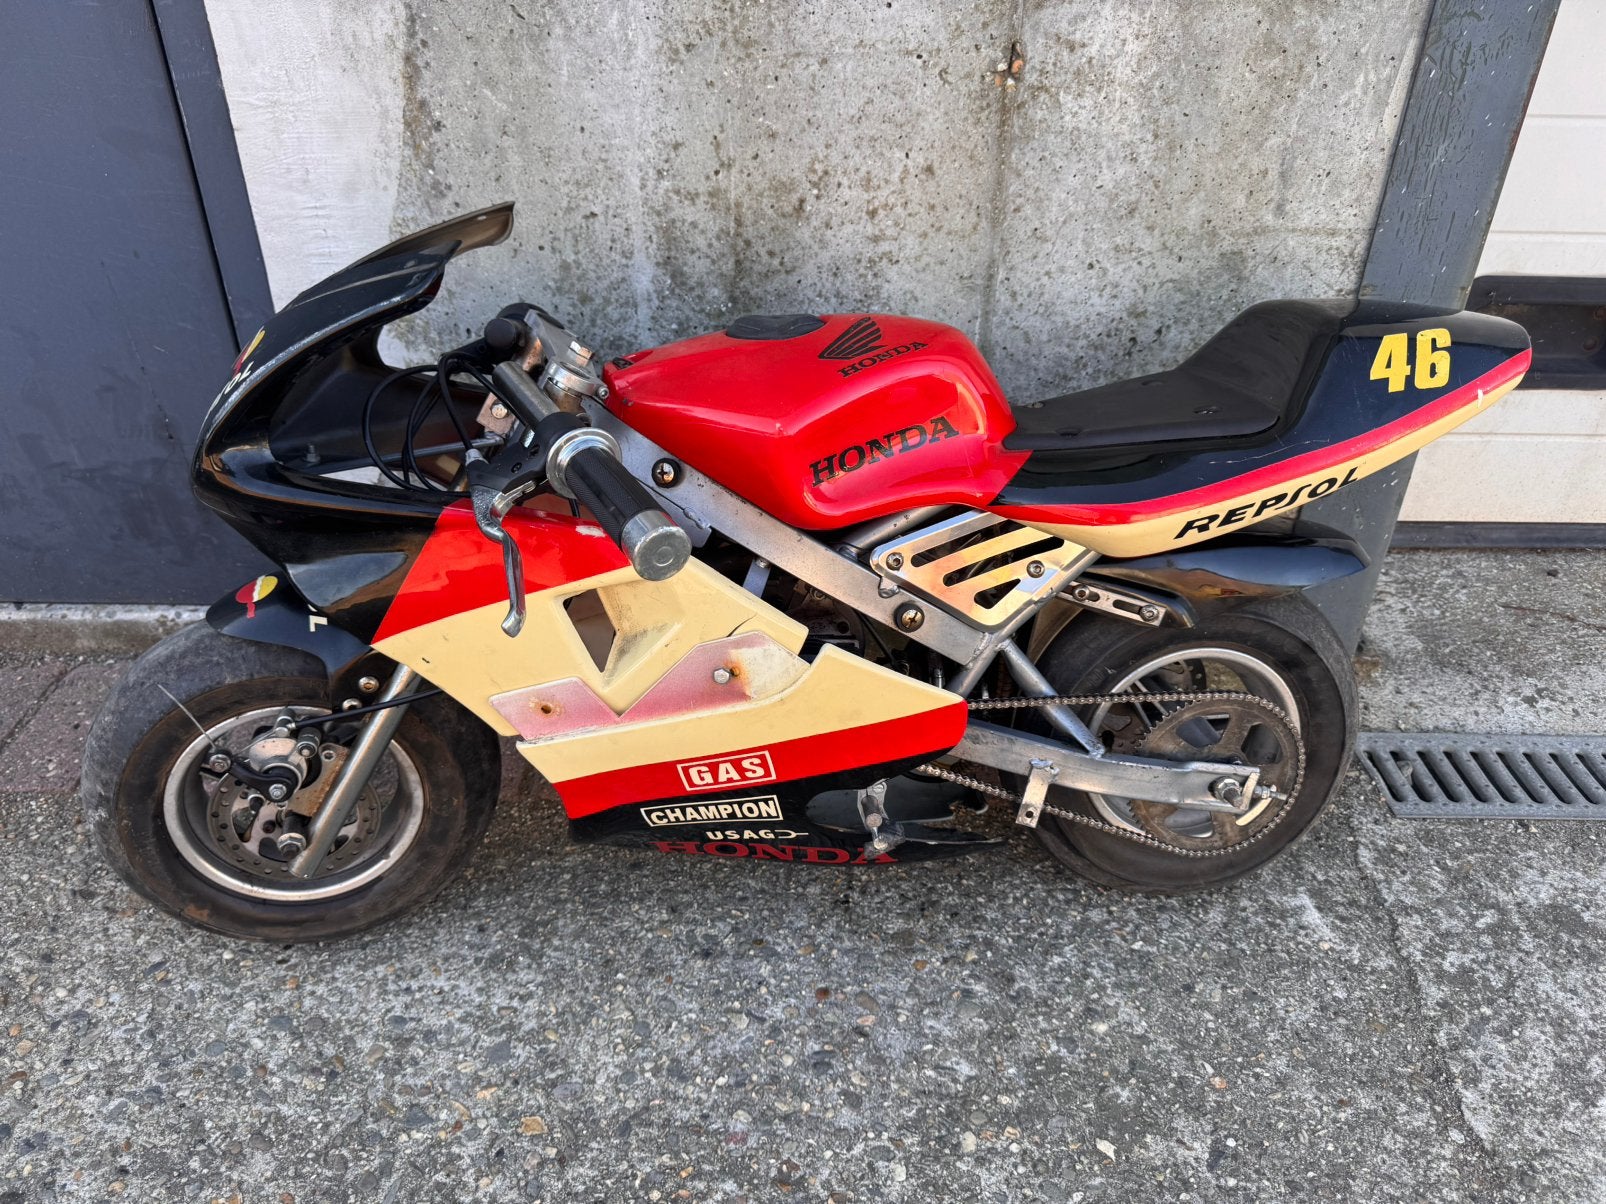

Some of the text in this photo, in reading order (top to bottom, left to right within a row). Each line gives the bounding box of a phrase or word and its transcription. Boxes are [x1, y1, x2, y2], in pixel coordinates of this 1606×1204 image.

[839, 341, 928, 377] HONDA
[1369, 328, 1452, 393] 46
[809, 416, 960, 487] HONDA
[1173, 466, 1359, 540] REPSOL
[688, 757, 766, 786] GAS
[650, 800, 777, 824] CHAMPION
[706, 829, 775, 840] USAG
